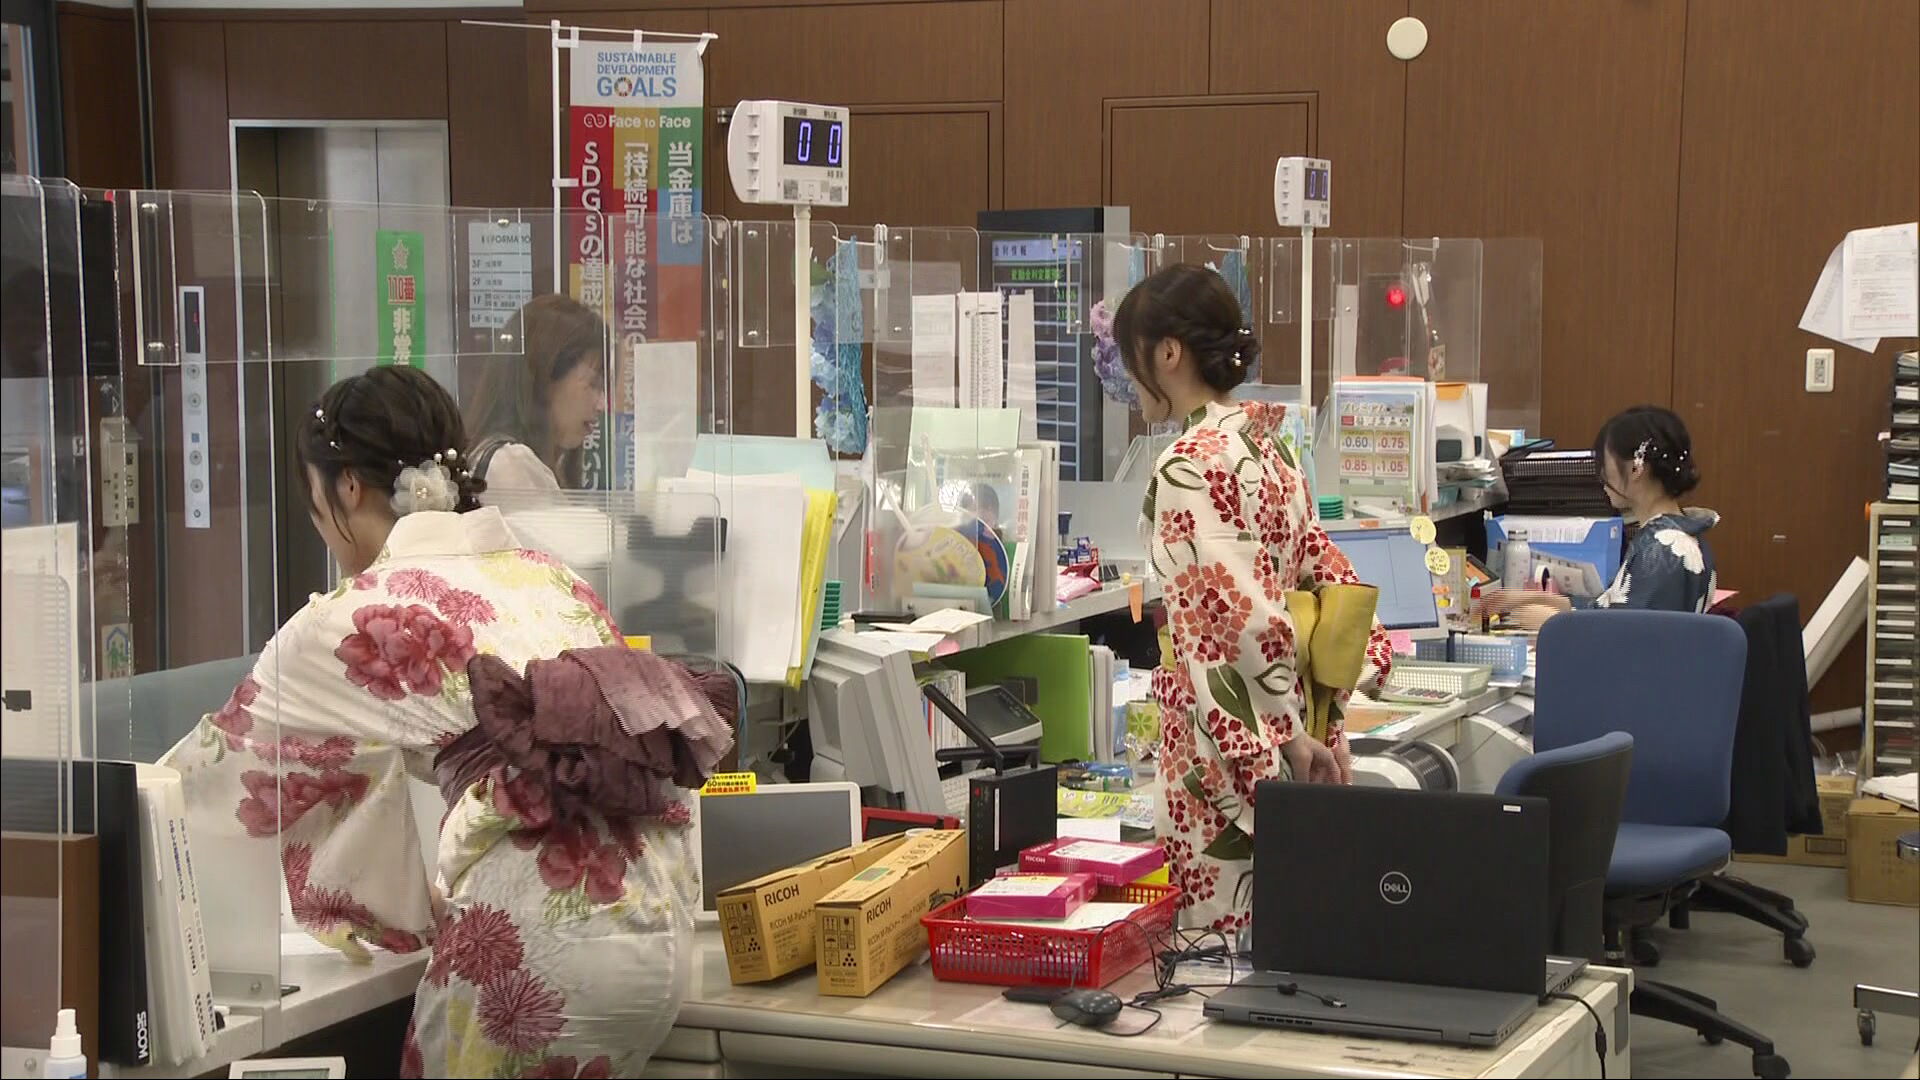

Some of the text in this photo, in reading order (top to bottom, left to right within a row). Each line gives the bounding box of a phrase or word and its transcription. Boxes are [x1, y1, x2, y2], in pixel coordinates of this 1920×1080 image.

[597, 52, 677, 64] SUSTAINABLE
[597, 64, 676, 75] DEVELOPMENT
[596, 76, 677, 97] GOALS
[609, 114, 691, 128] Face to Face
[797, 121, 841, 164] 0 0
[668, 141, 693, 244] 当金庫は
[387, 274, 416, 301] 110番
[392, 306, 412, 366] 非常
[1345, 436, 1404, 449] 0.60 0.75
[1344, 459, 1404, 472] 0.85 1.05
[1025, 855, 1046, 863] RICOH
[764, 884, 800, 907] RICOH
[1383, 882, 1408, 893] DELL
[866, 897, 892, 924] RICOH
[136, 1010, 147, 1059] SECOM
